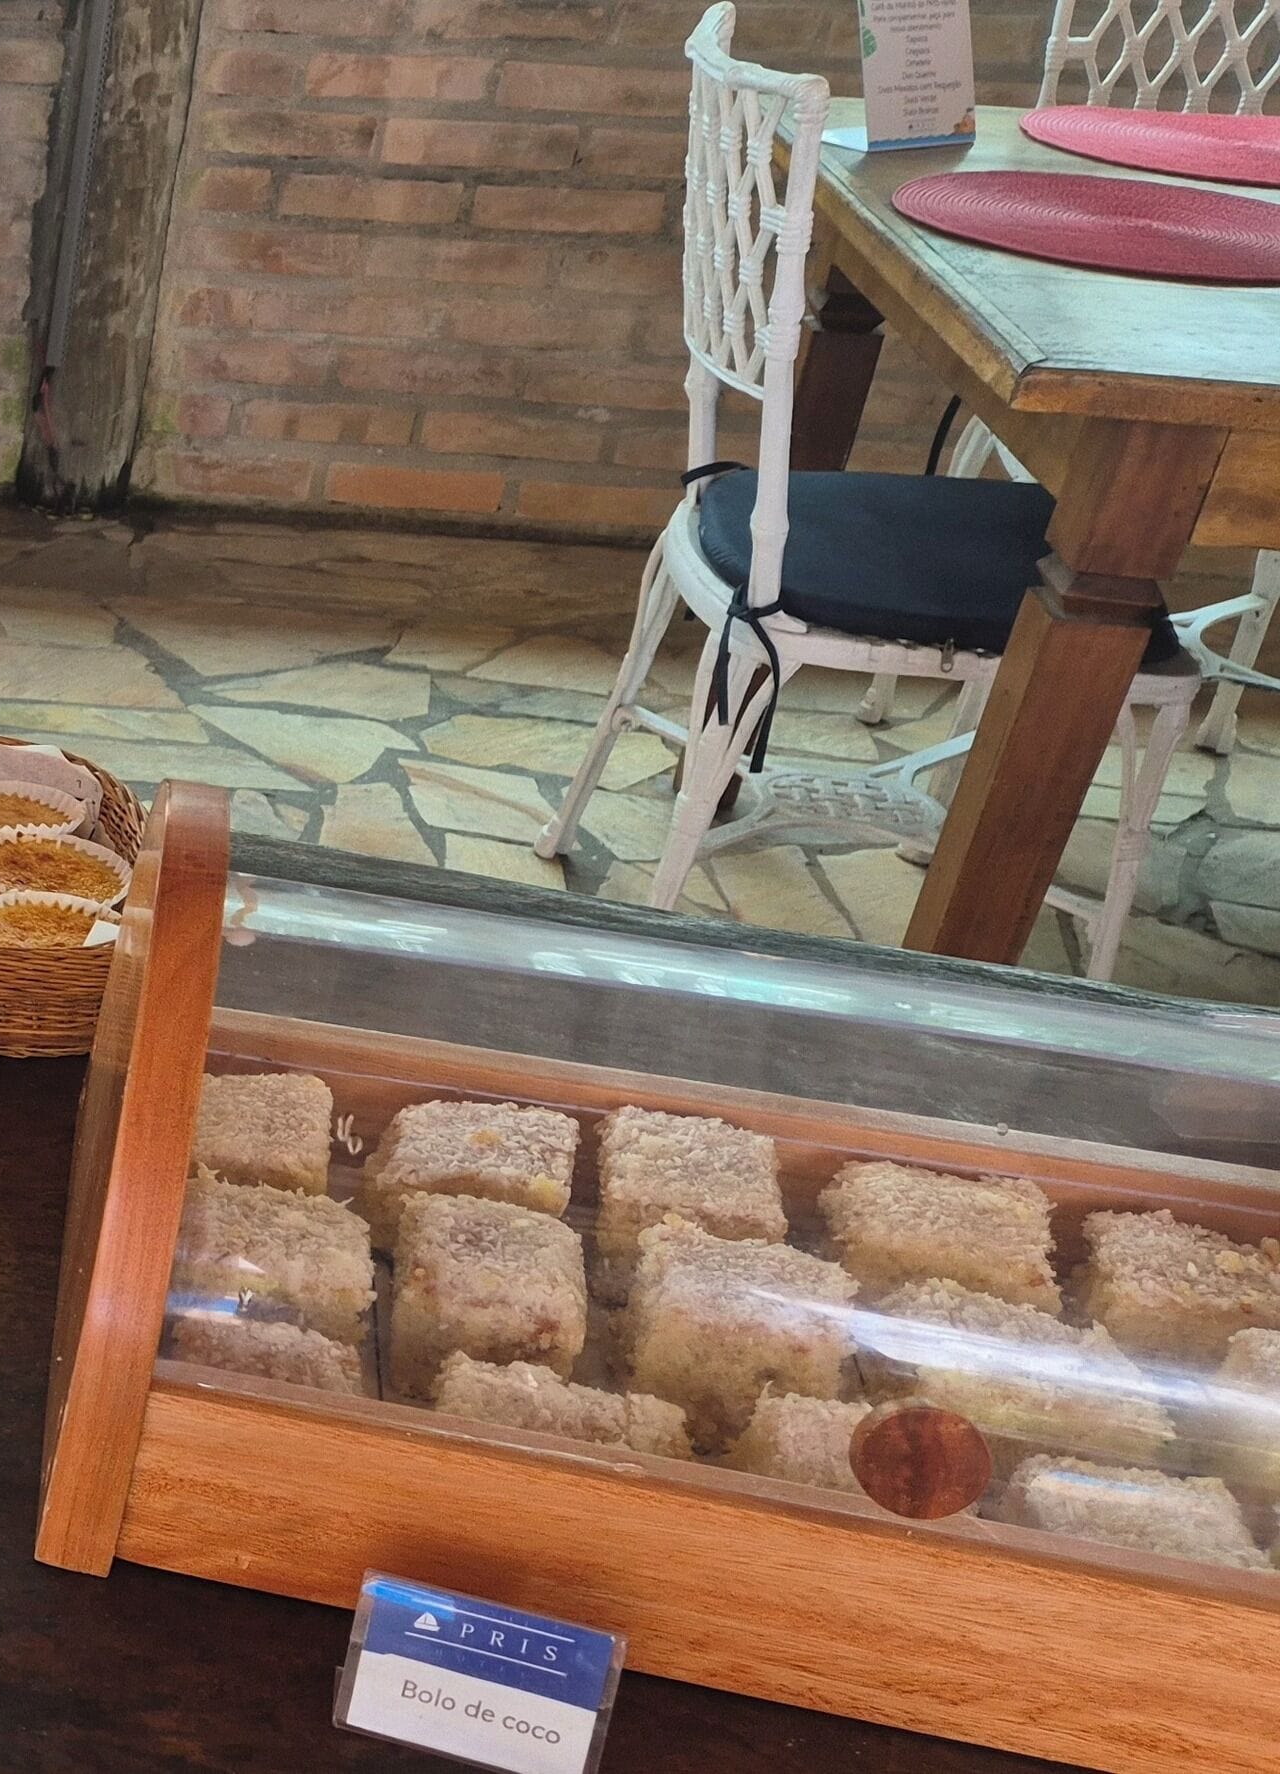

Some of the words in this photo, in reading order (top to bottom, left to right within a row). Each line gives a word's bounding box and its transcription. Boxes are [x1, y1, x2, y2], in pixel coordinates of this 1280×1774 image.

[459, 1622, 559, 1663] PRIS
[400, 1678, 456, 1712] Bolo
[464, 1699, 496, 1723] de
[502, 1712, 561, 1746] coco
